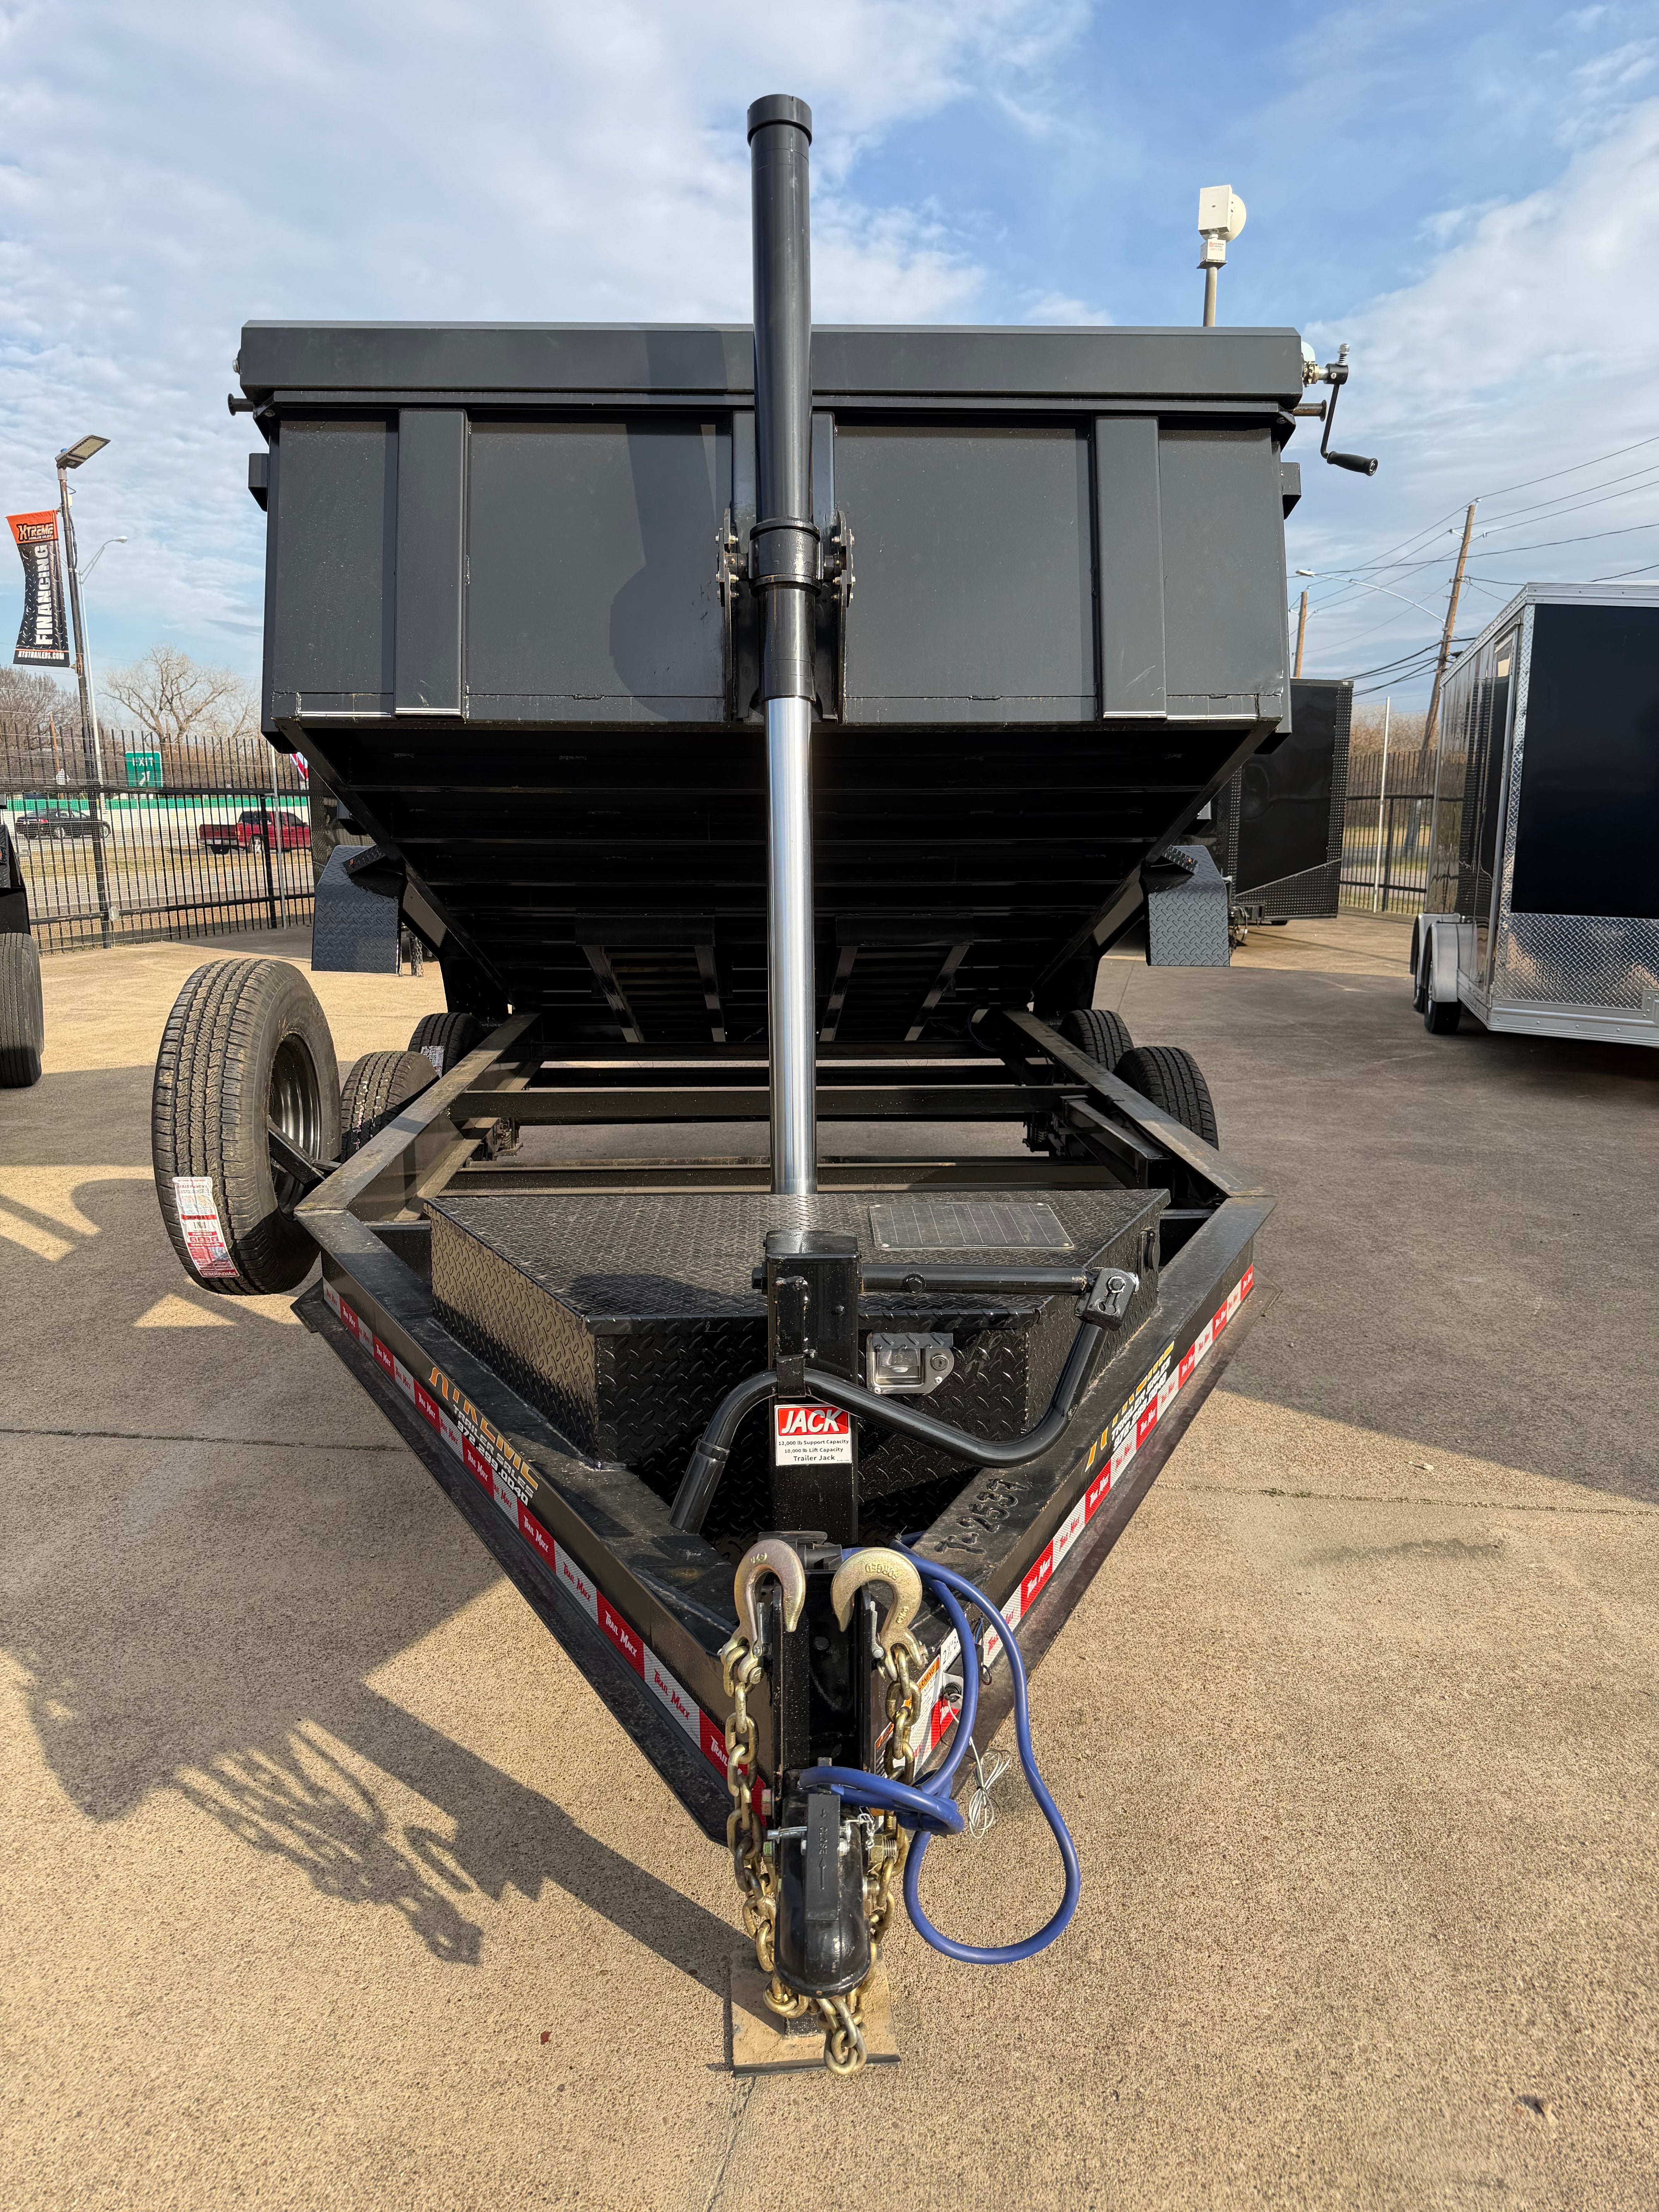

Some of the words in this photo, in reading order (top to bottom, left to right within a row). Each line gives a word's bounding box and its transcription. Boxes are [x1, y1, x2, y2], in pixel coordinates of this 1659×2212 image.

[18, 524, 53, 540] XTREME
[34, 545, 53, 645] FINANCING
[18, 651, 65, 659] XTSTRAILERS.COM
[132, 757, 153, 766] EXIT
[781, 1409, 843, 1434] JACK
[1111, 1389, 1146, 1441] TRAILER
[453, 1404, 494, 1455] TRAILER
[496, 1453, 534, 1498] SALES
[865, 1563, 900, 1581] FORGED
[918, 1666, 934, 1690] ARNING
[819, 1826, 828, 1855] CLOSE
